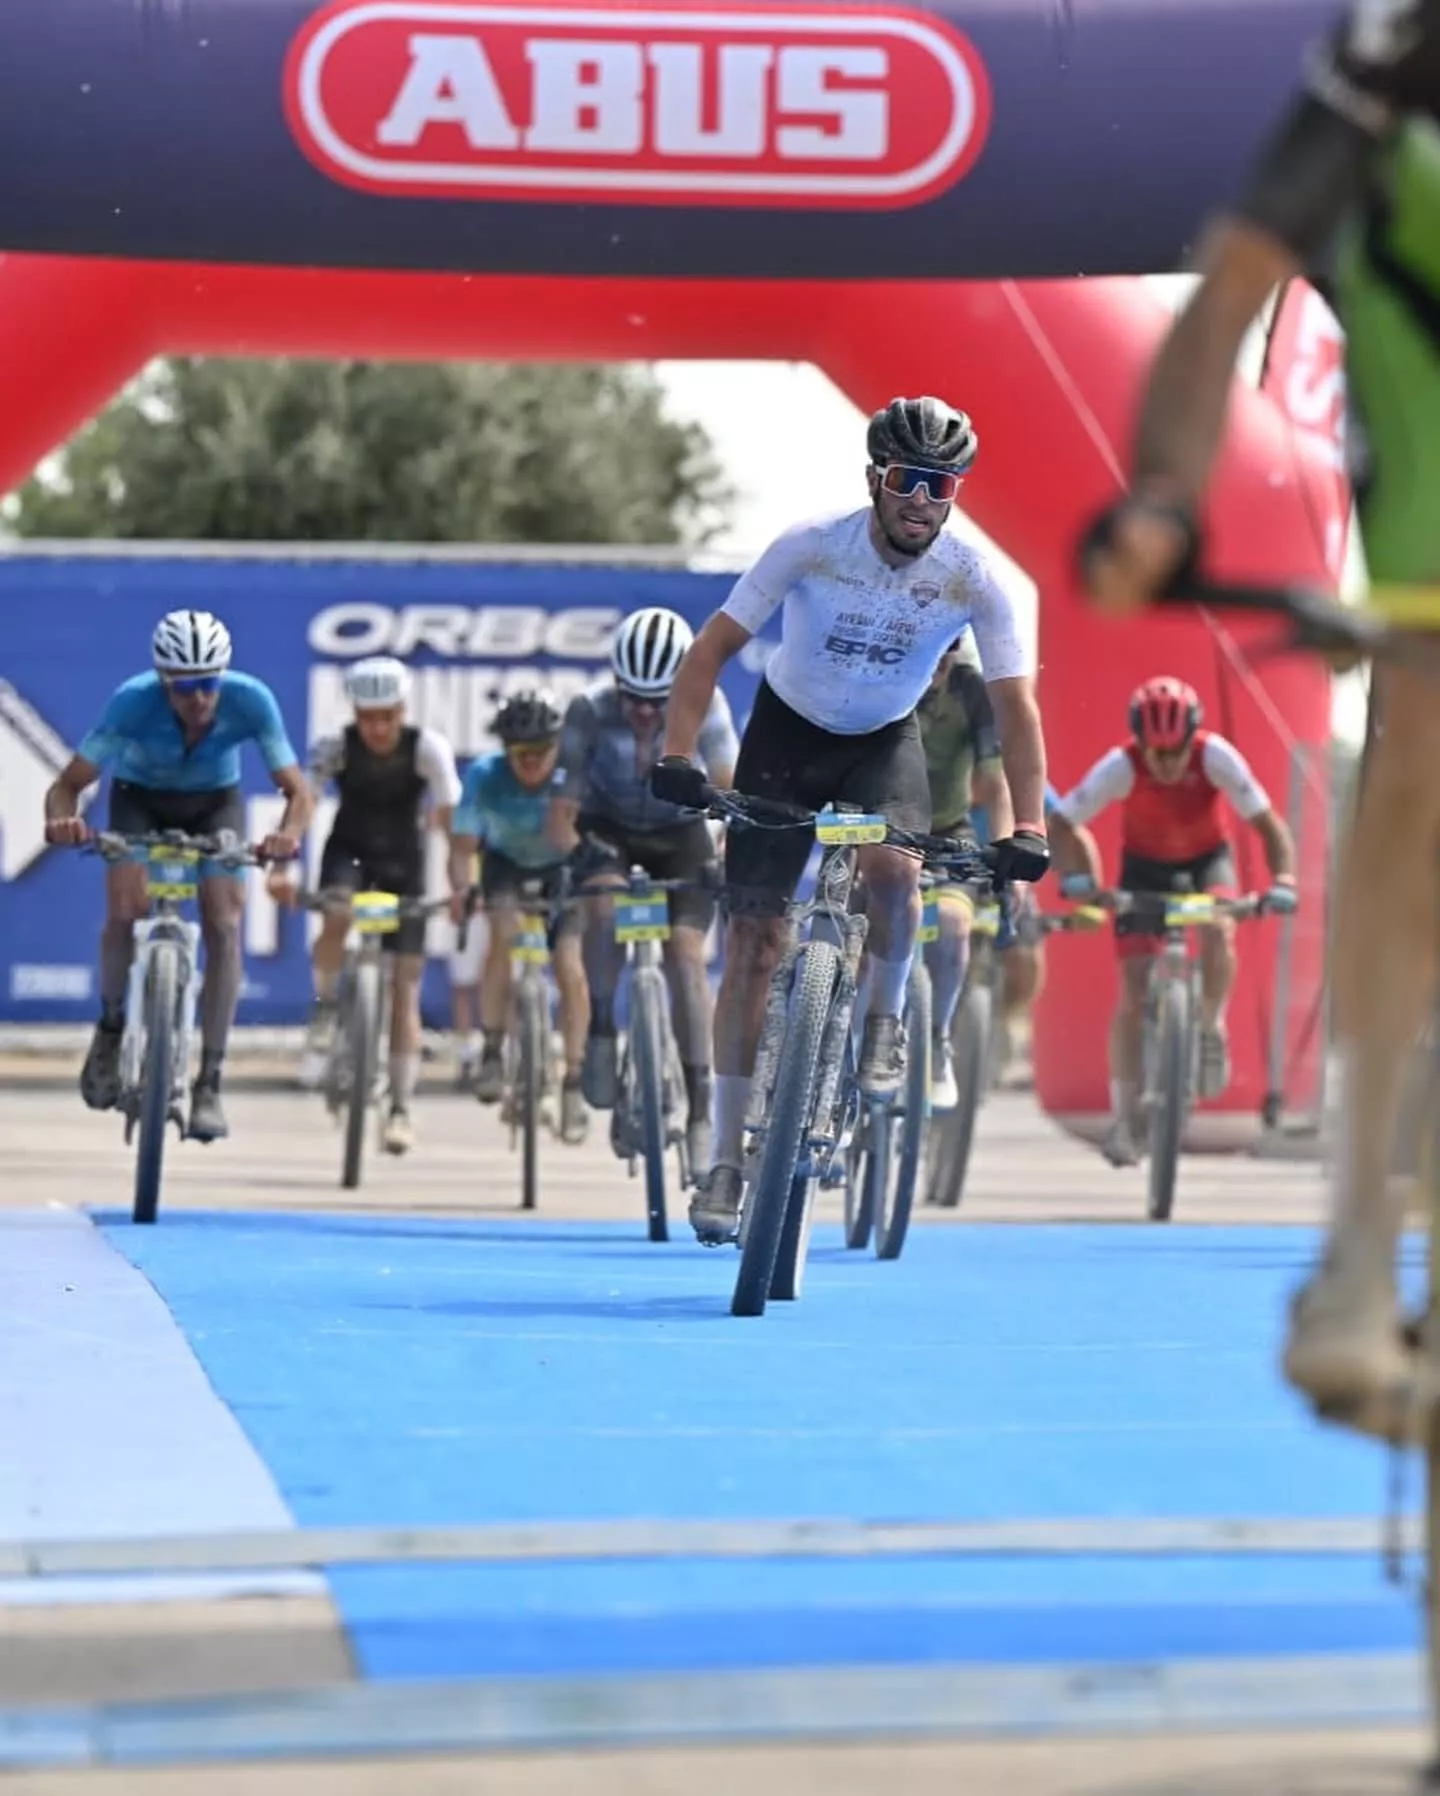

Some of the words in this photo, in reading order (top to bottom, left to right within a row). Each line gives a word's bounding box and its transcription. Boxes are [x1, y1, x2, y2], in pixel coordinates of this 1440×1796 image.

[376, 34, 888, 160] ABUS
[308, 603, 622, 657] ORBE
[825, 635, 906, 665] EPIC
